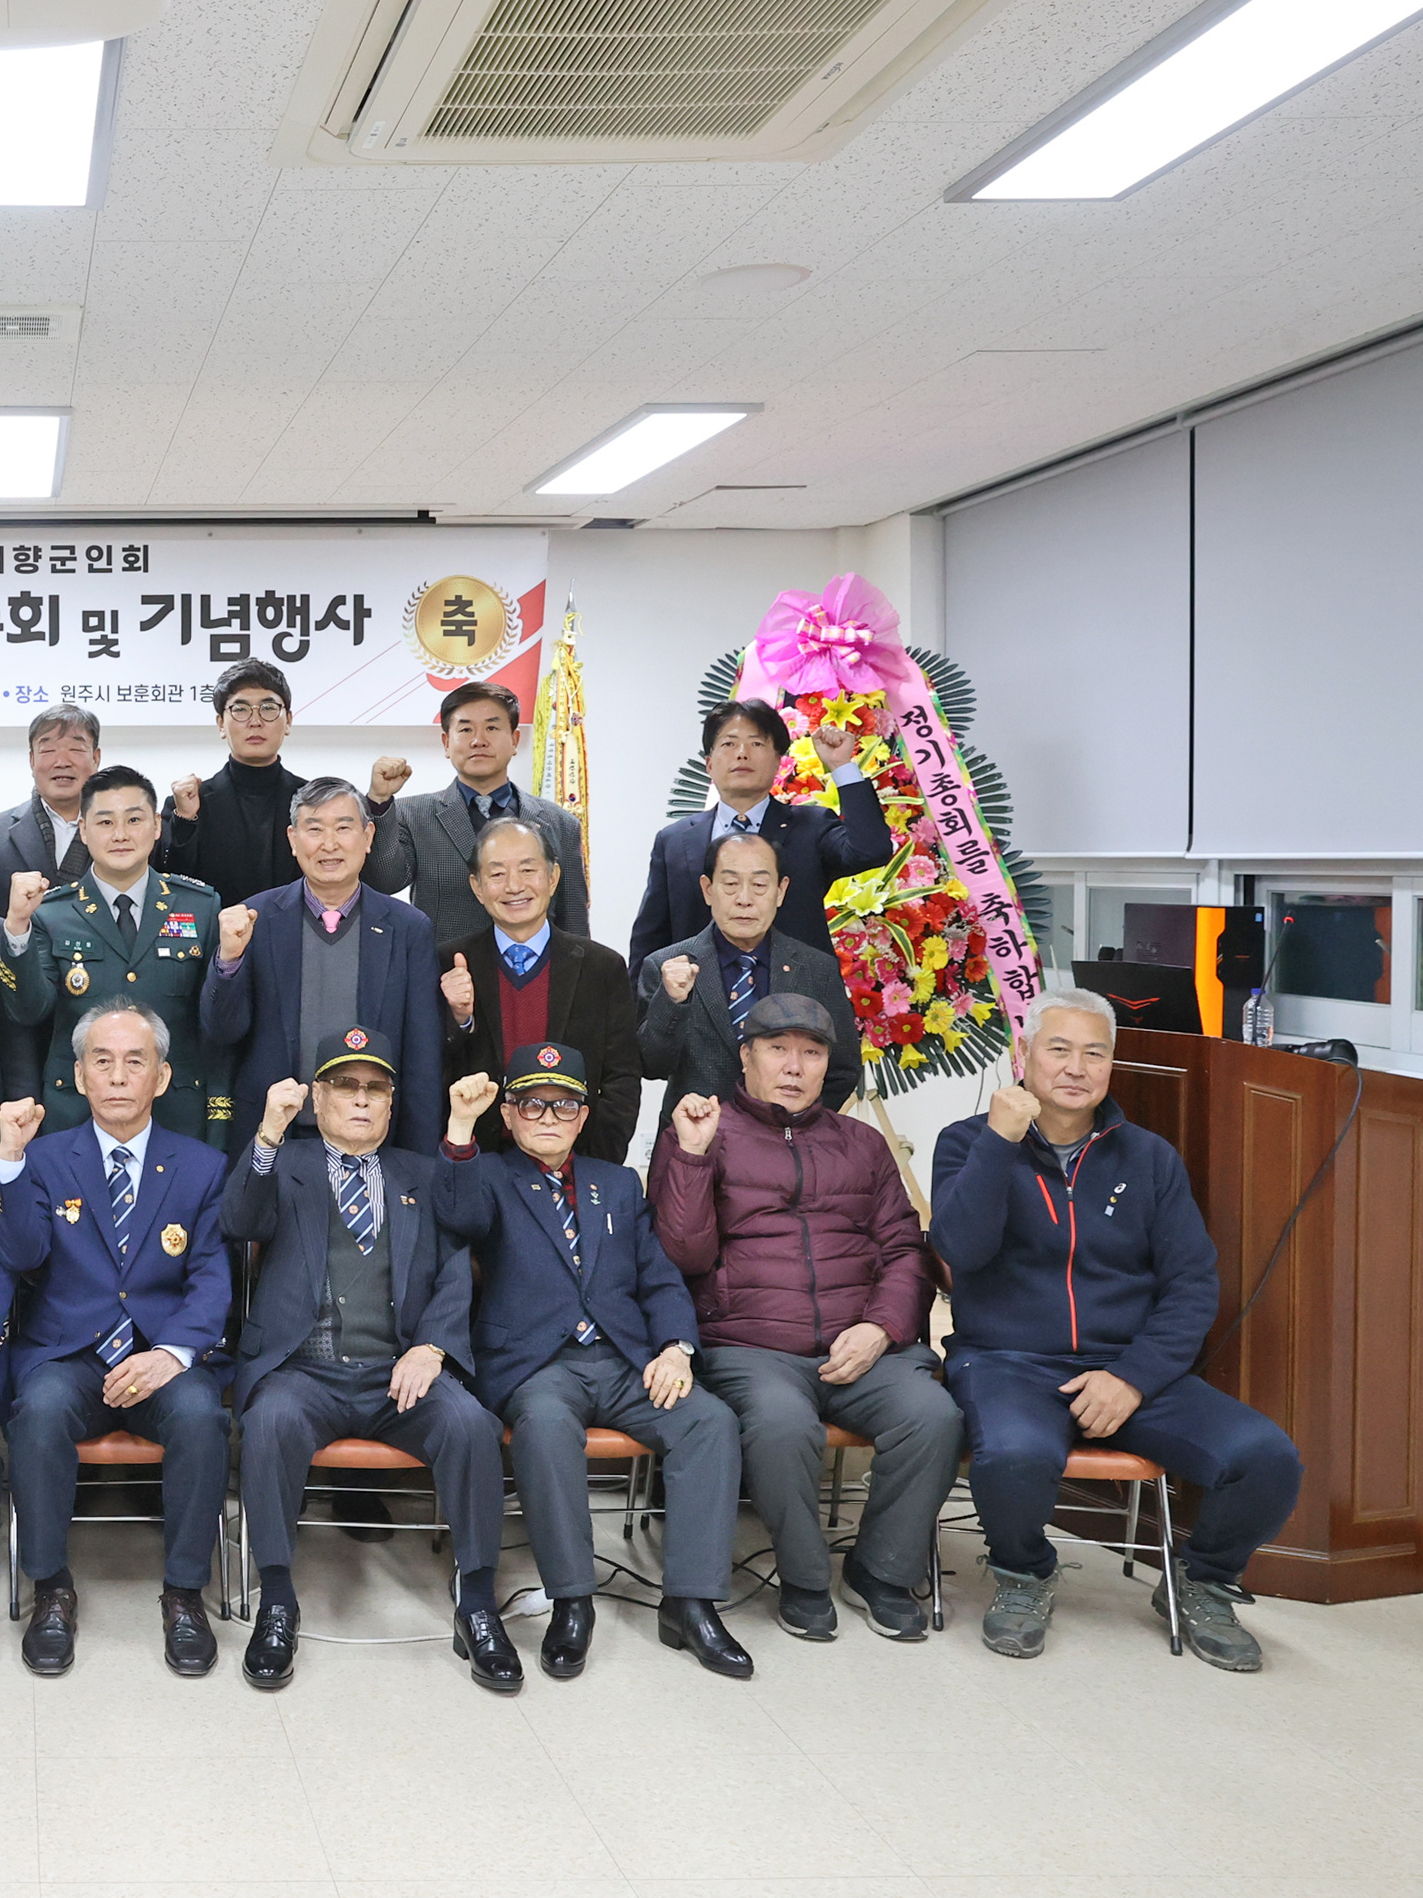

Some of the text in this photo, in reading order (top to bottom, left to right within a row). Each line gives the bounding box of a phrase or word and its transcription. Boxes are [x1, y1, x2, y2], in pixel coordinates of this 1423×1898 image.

[82, 609, 121, 659] 및
[139, 589, 372, 664] 기념행사
[440, 595, 478, 647] 축
[14, 684, 215, 704] 장소 원주시 보훈회관 1층
[900, 705, 1039, 1029] 정기총회를 축하합
